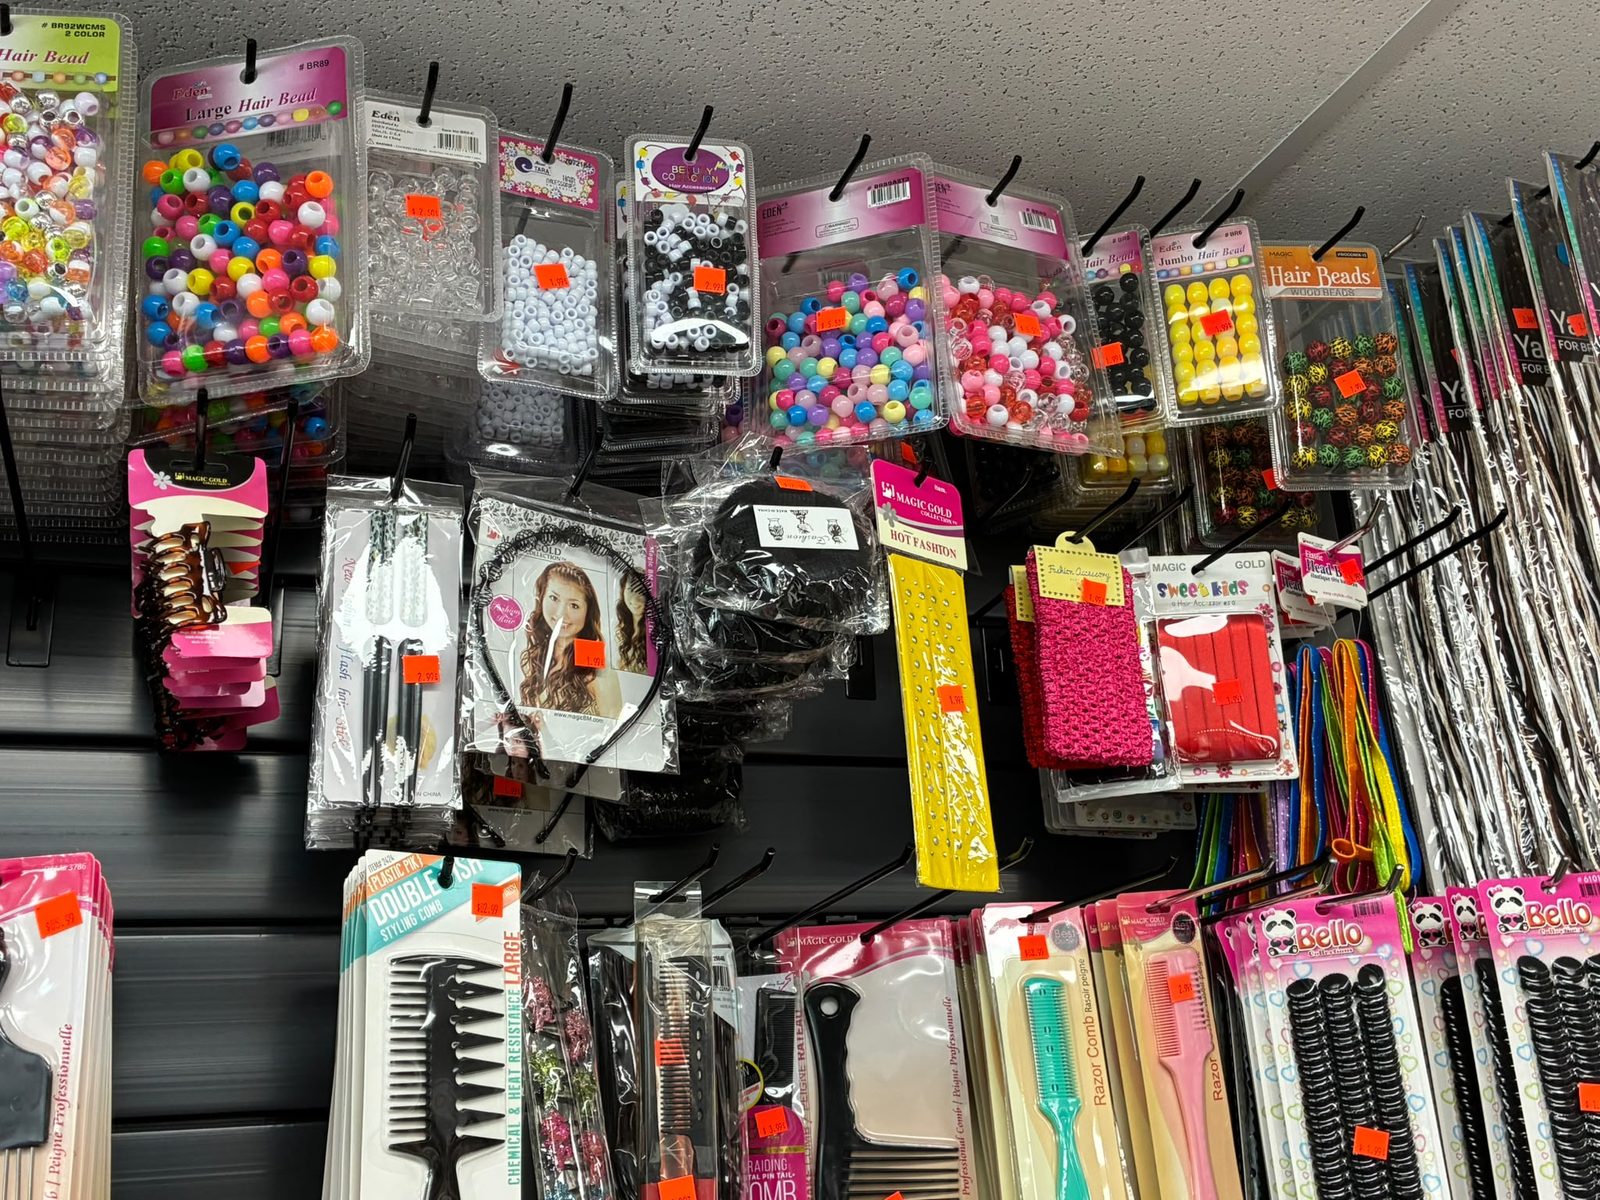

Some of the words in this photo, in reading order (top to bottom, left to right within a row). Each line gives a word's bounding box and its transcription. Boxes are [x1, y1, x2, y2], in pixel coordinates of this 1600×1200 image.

[51, 22, 106, 30] BR92WCMS
[0, 48, 38, 62] Hair
[44, 50, 90, 64] Bead
[306, 60, 330, 70] BR89
[173, 86, 209, 100] Eden
[186, 104, 232, 122] Large
[238, 98, 274, 112] Hair
[278, 88, 318, 106] Bead
[372, 110, 400, 122] Eden
[672, 165, 714, 175] BEUY
[1108, 252, 1135, 263] Bead
[1158, 255, 1194, 267] Jumbo
[1197, 250, 1218, 260] Hair
[1222, 245, 1246, 257] Bead
[1159, 244, 1182, 253] Eden
[1269, 265, 1311, 287] Hair
[1316, 265, 1371, 287] Beads
[1558, 340, 1580, 351] FOR
[1521, 363, 1543, 374] FOR
[896, 492, 927, 510] MAGIC
[928, 502, 952, 518] GOLD
[920, 510, 952, 524] COLLECTION
[787, 535, 830, 545] Fashion
[890, 530, 911, 545] HOT
[913, 534, 957, 558] FASHION
[344, 558, 356, 584] New
[1048, 564, 1074, 576] Fashion
[1075, 567, 1111, 582] Accessory
[1153, 563, 1186, 572] MAGIC
[1235, 560, 1266, 569] GOLD
[1306, 558, 1332, 576] Head
[336, 644, 353, 680] flash
[368, 869, 442, 927] DOUBLE
[380, 913, 418, 942] STYLING
[418, 899, 444, 922] COMB
[1525, 898, 1592, 930] Bello
[800, 937, 827, 945] MAGIC
[829, 936, 854, 944] GOLD
[1297, 919, 1363, 951] Bello
[503, 930, 521, 985] LARGE
[1078, 958, 1089, 986] peigne
[508, 990, 521, 1064] RESISTANCE
[945, 997, 959, 1066] Professionnelle
[1087, 1014, 1099, 1058] Comb
[55, 1024, 73, 1126] Professionnelle
[508, 1069, 520, 1098] HEAT
[952, 1070, 962, 1098] Peigne
[1094, 1062, 1107, 1106] Razor
[1210, 1057, 1224, 1101] Razor
[508, 1106, 520, 1115] &
[956, 1108, 966, 1134] Comb
[48, 1131, 67, 1175] Peigne
[508, 1122, 520, 1186] CHEMICAL
[748, 1158, 788, 1173] RAIDING
[958, 1137, 972, 1196] Professional
[749, 1180, 797, 1200] OMB
